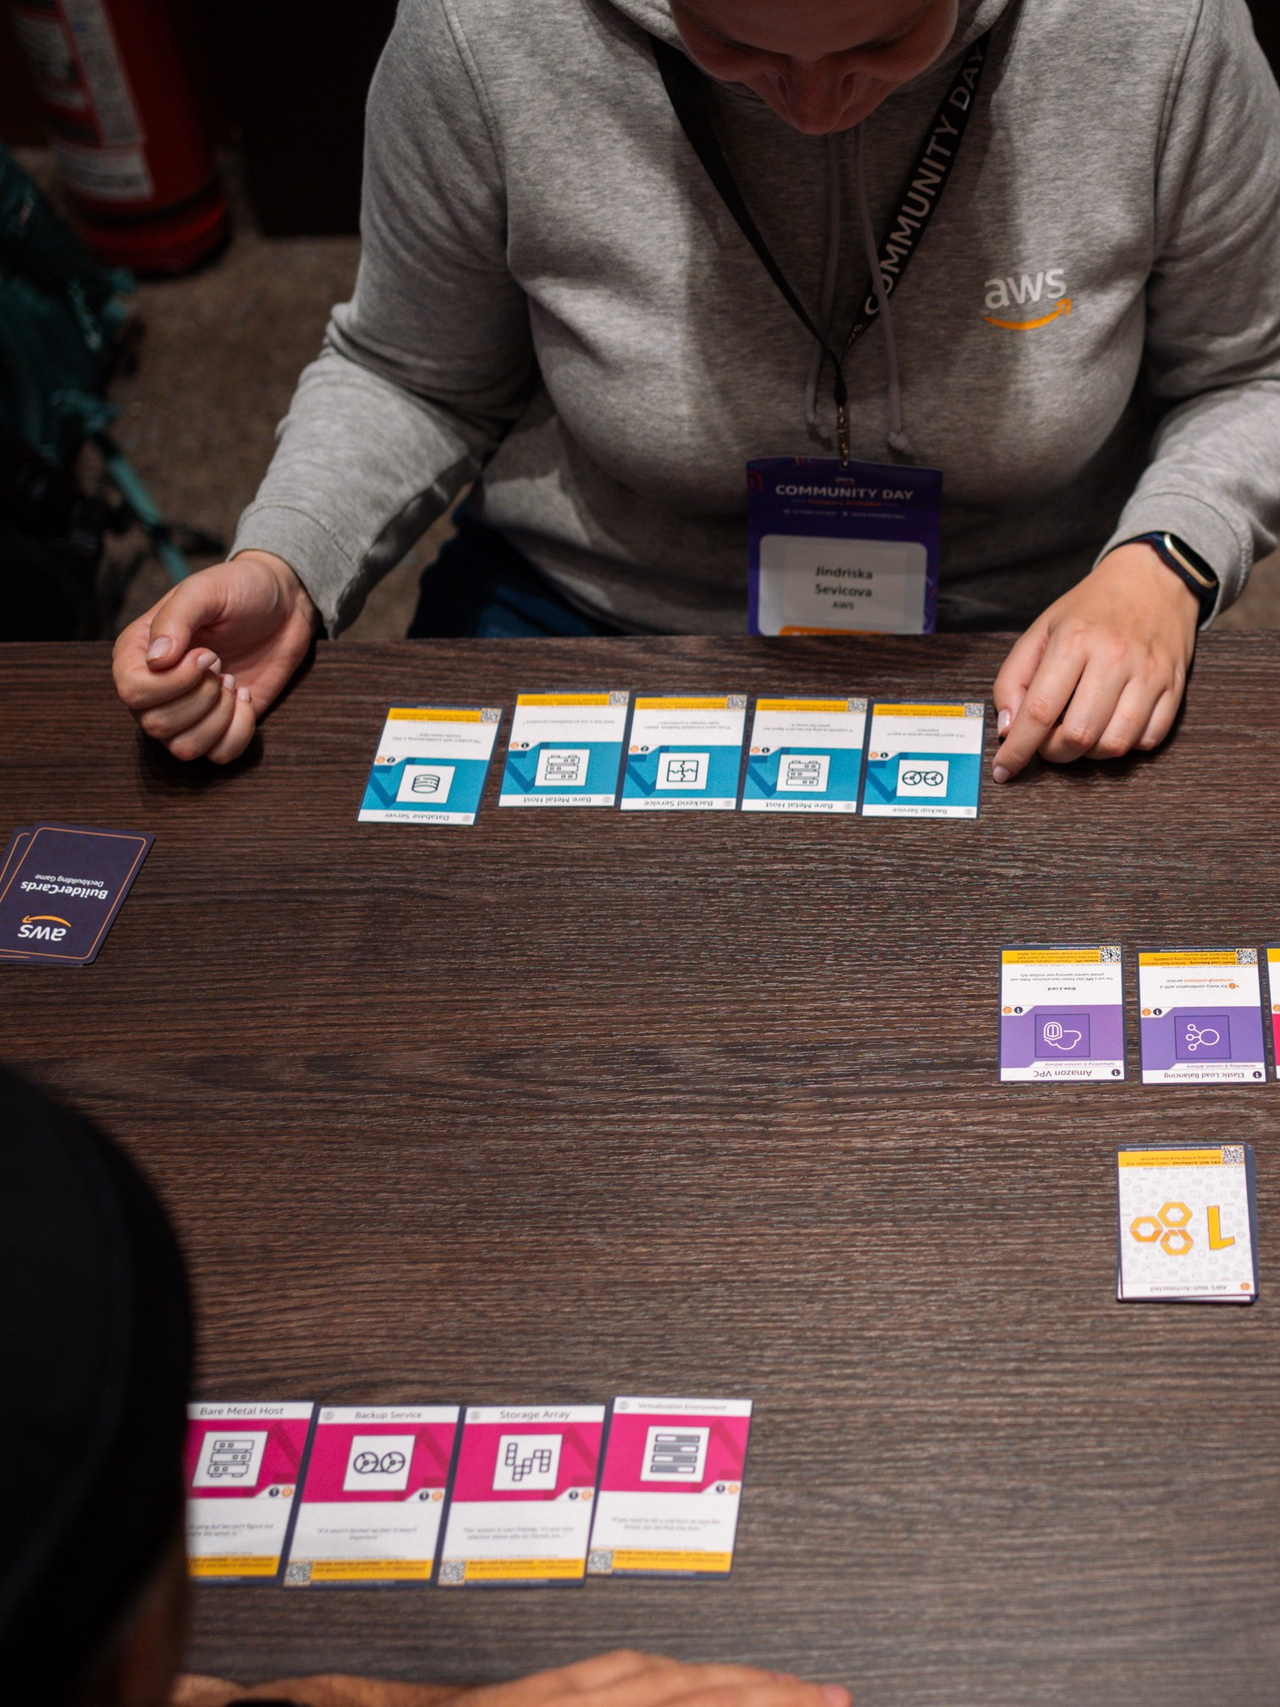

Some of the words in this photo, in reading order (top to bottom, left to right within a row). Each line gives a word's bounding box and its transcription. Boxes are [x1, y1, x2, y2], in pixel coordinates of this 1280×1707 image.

[949, 45, 984, 112] DAY
[984, 268, 1068, 309] aws
[775, 485, 878, 499] COMMUNITY
[882, 489, 915, 500] DAY
[814, 566, 873, 580] Jindriska
[814, 584, 873, 598] Sevicova
[412, 813, 449, 821] Database
[35, 874, 56, 882] Game
[57, 876, 104, 888] Deckbuilding
[21, 881, 108, 899] BuilderCards
[18, 924, 67, 942] aws
[1164, 1072, 1199, 1080] Balancing
[1207, 1205, 1235, 1251] 1
[200, 1407, 224, 1416] Bare
[227, 1407, 256, 1415] Metal
[260, 1406, 284, 1415] Host
[355, 1411, 388, 1420] Backup
[390, 1411, 422, 1419] Service
[500, 1411, 540, 1420] Storage
[543, 1410, 570, 1420] Array
